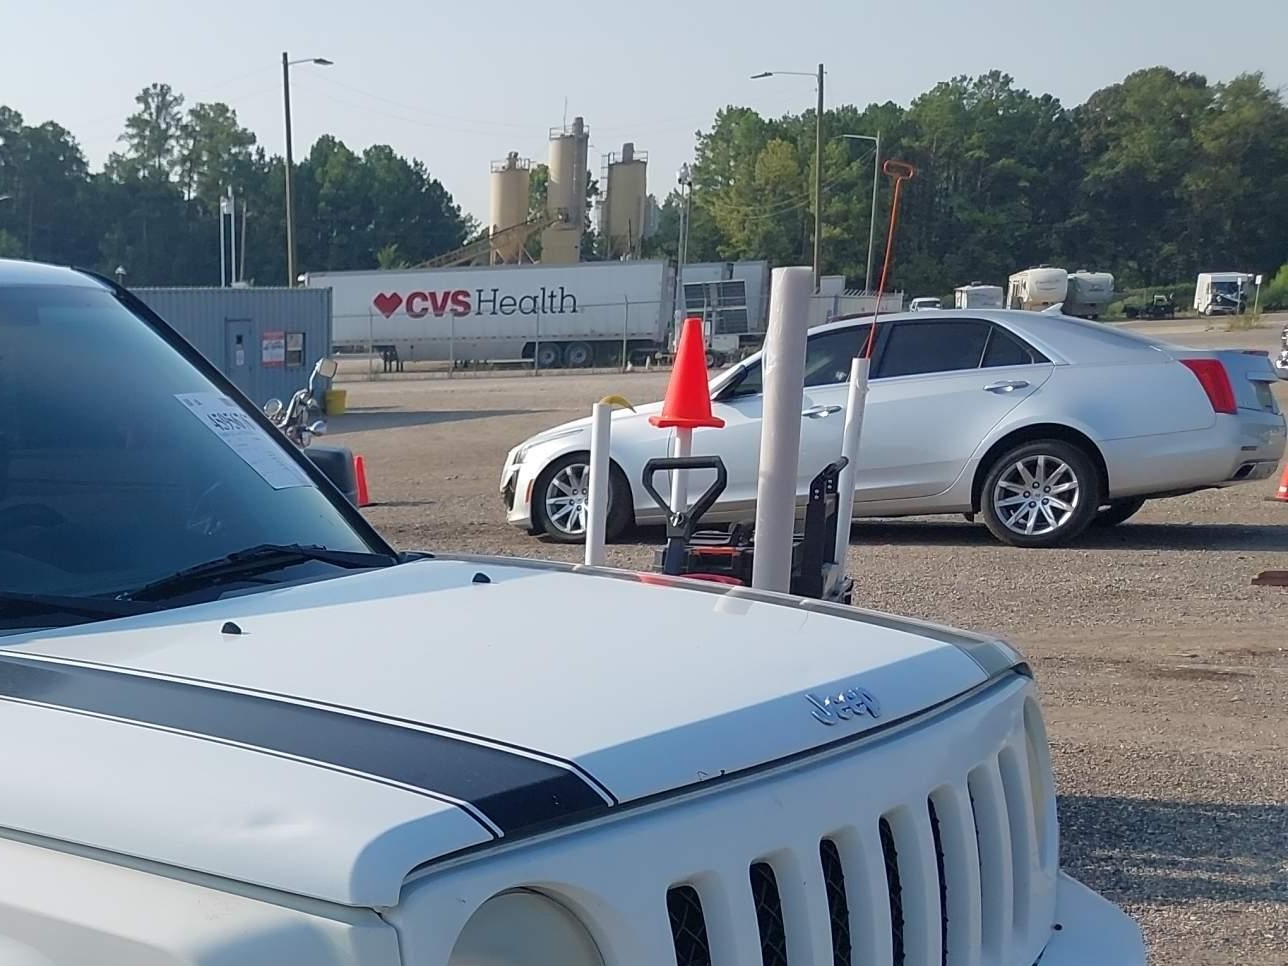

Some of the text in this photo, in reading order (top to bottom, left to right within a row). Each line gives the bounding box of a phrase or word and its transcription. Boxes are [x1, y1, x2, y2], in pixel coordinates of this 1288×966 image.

[405, 286, 579, 319] CVS Health
[803, 686, 881, 727] Jeep
